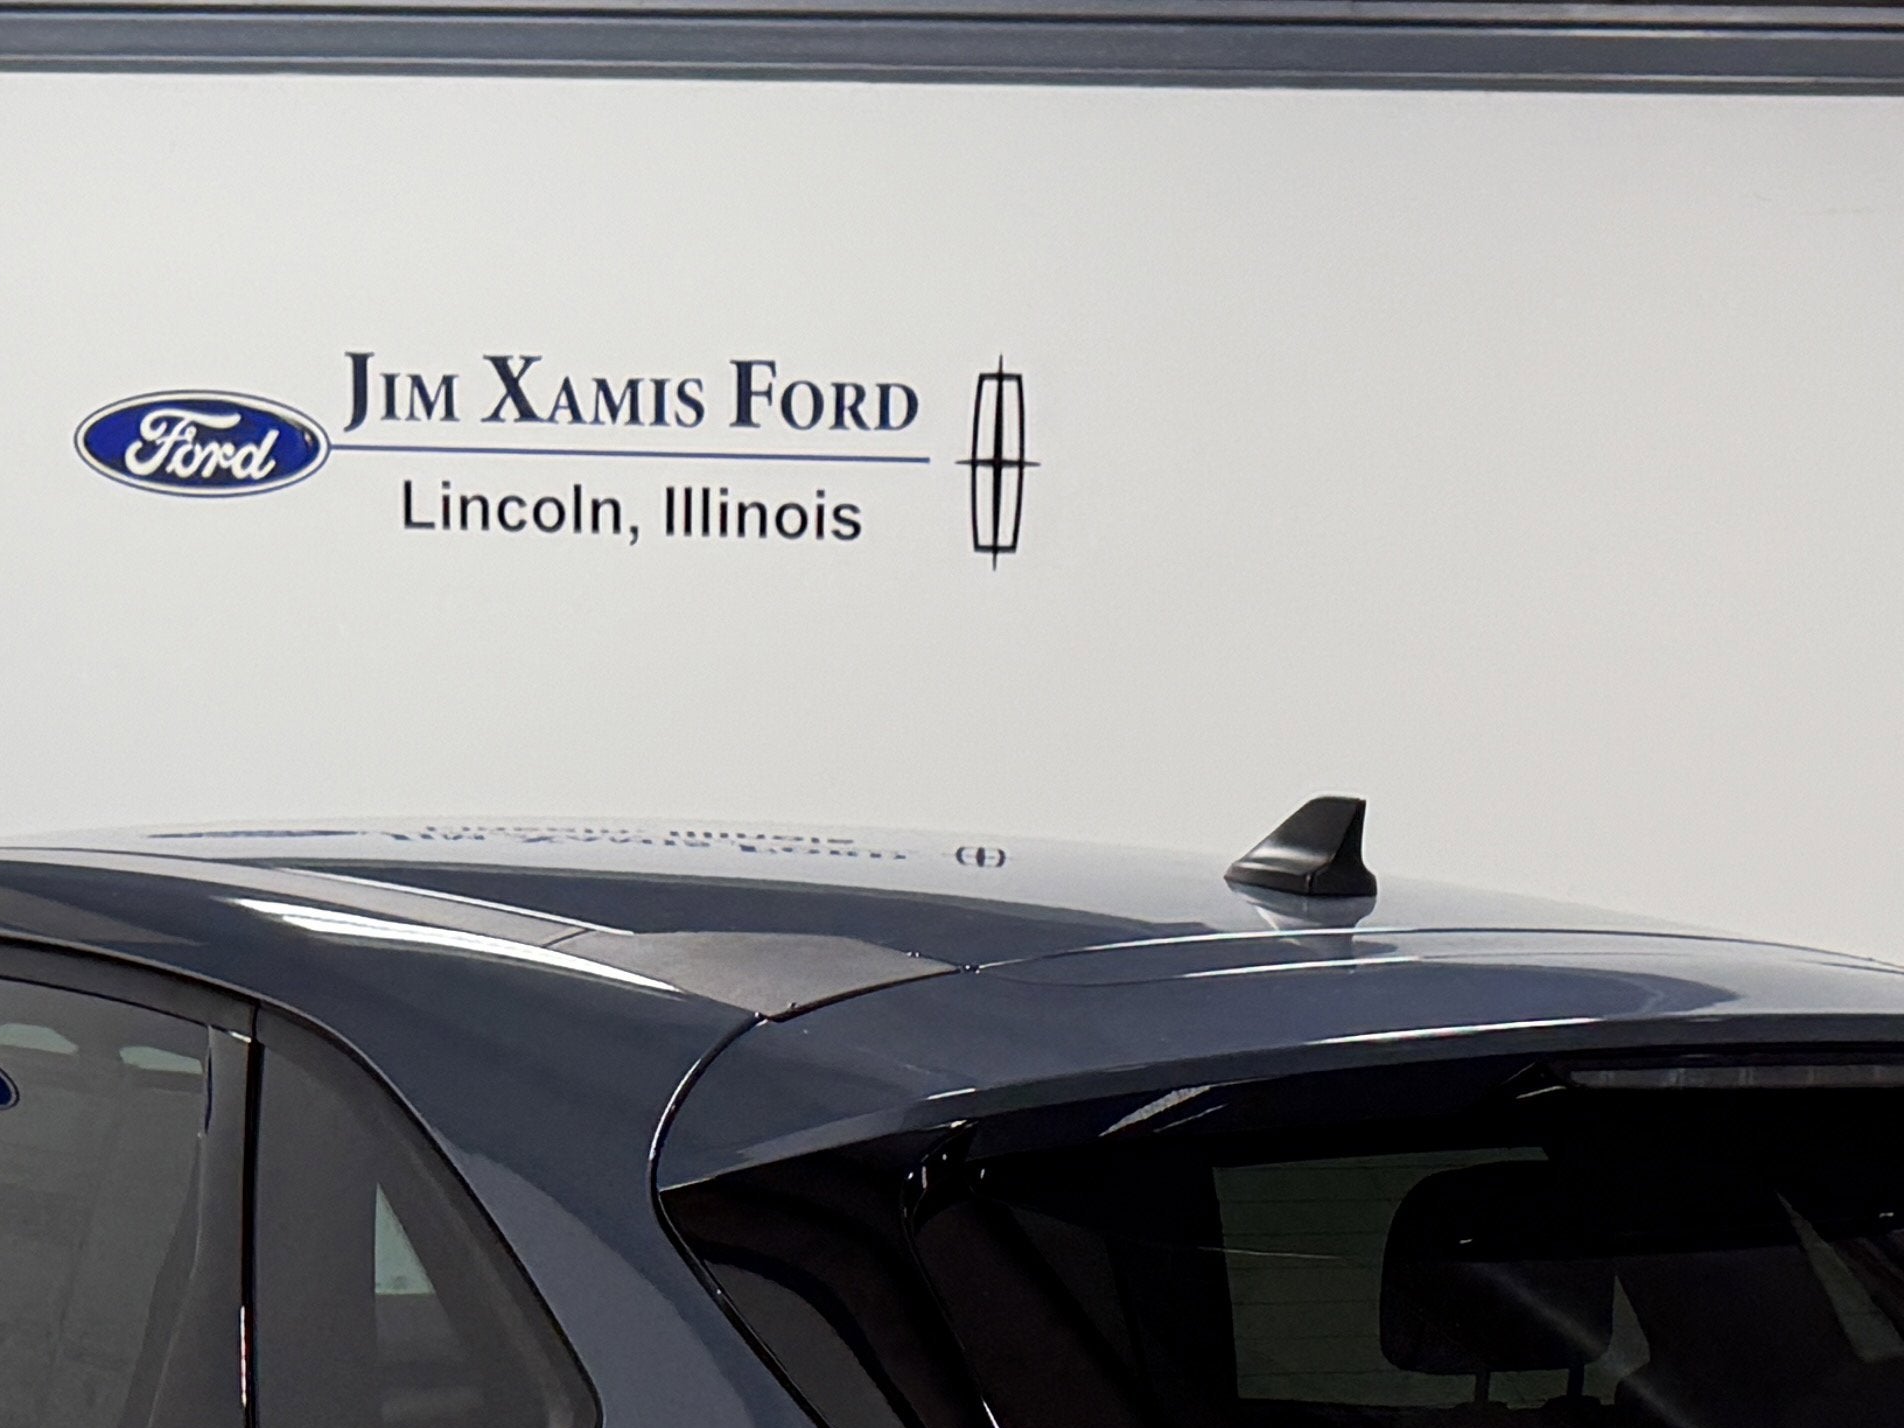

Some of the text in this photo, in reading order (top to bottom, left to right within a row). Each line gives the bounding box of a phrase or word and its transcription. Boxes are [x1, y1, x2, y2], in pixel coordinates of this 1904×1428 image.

[342, 350, 918, 433] JIM XAMIS FORD
[124, 407, 278, 484] Ford
[402, 479, 863, 545] Lincoln, Illinois
